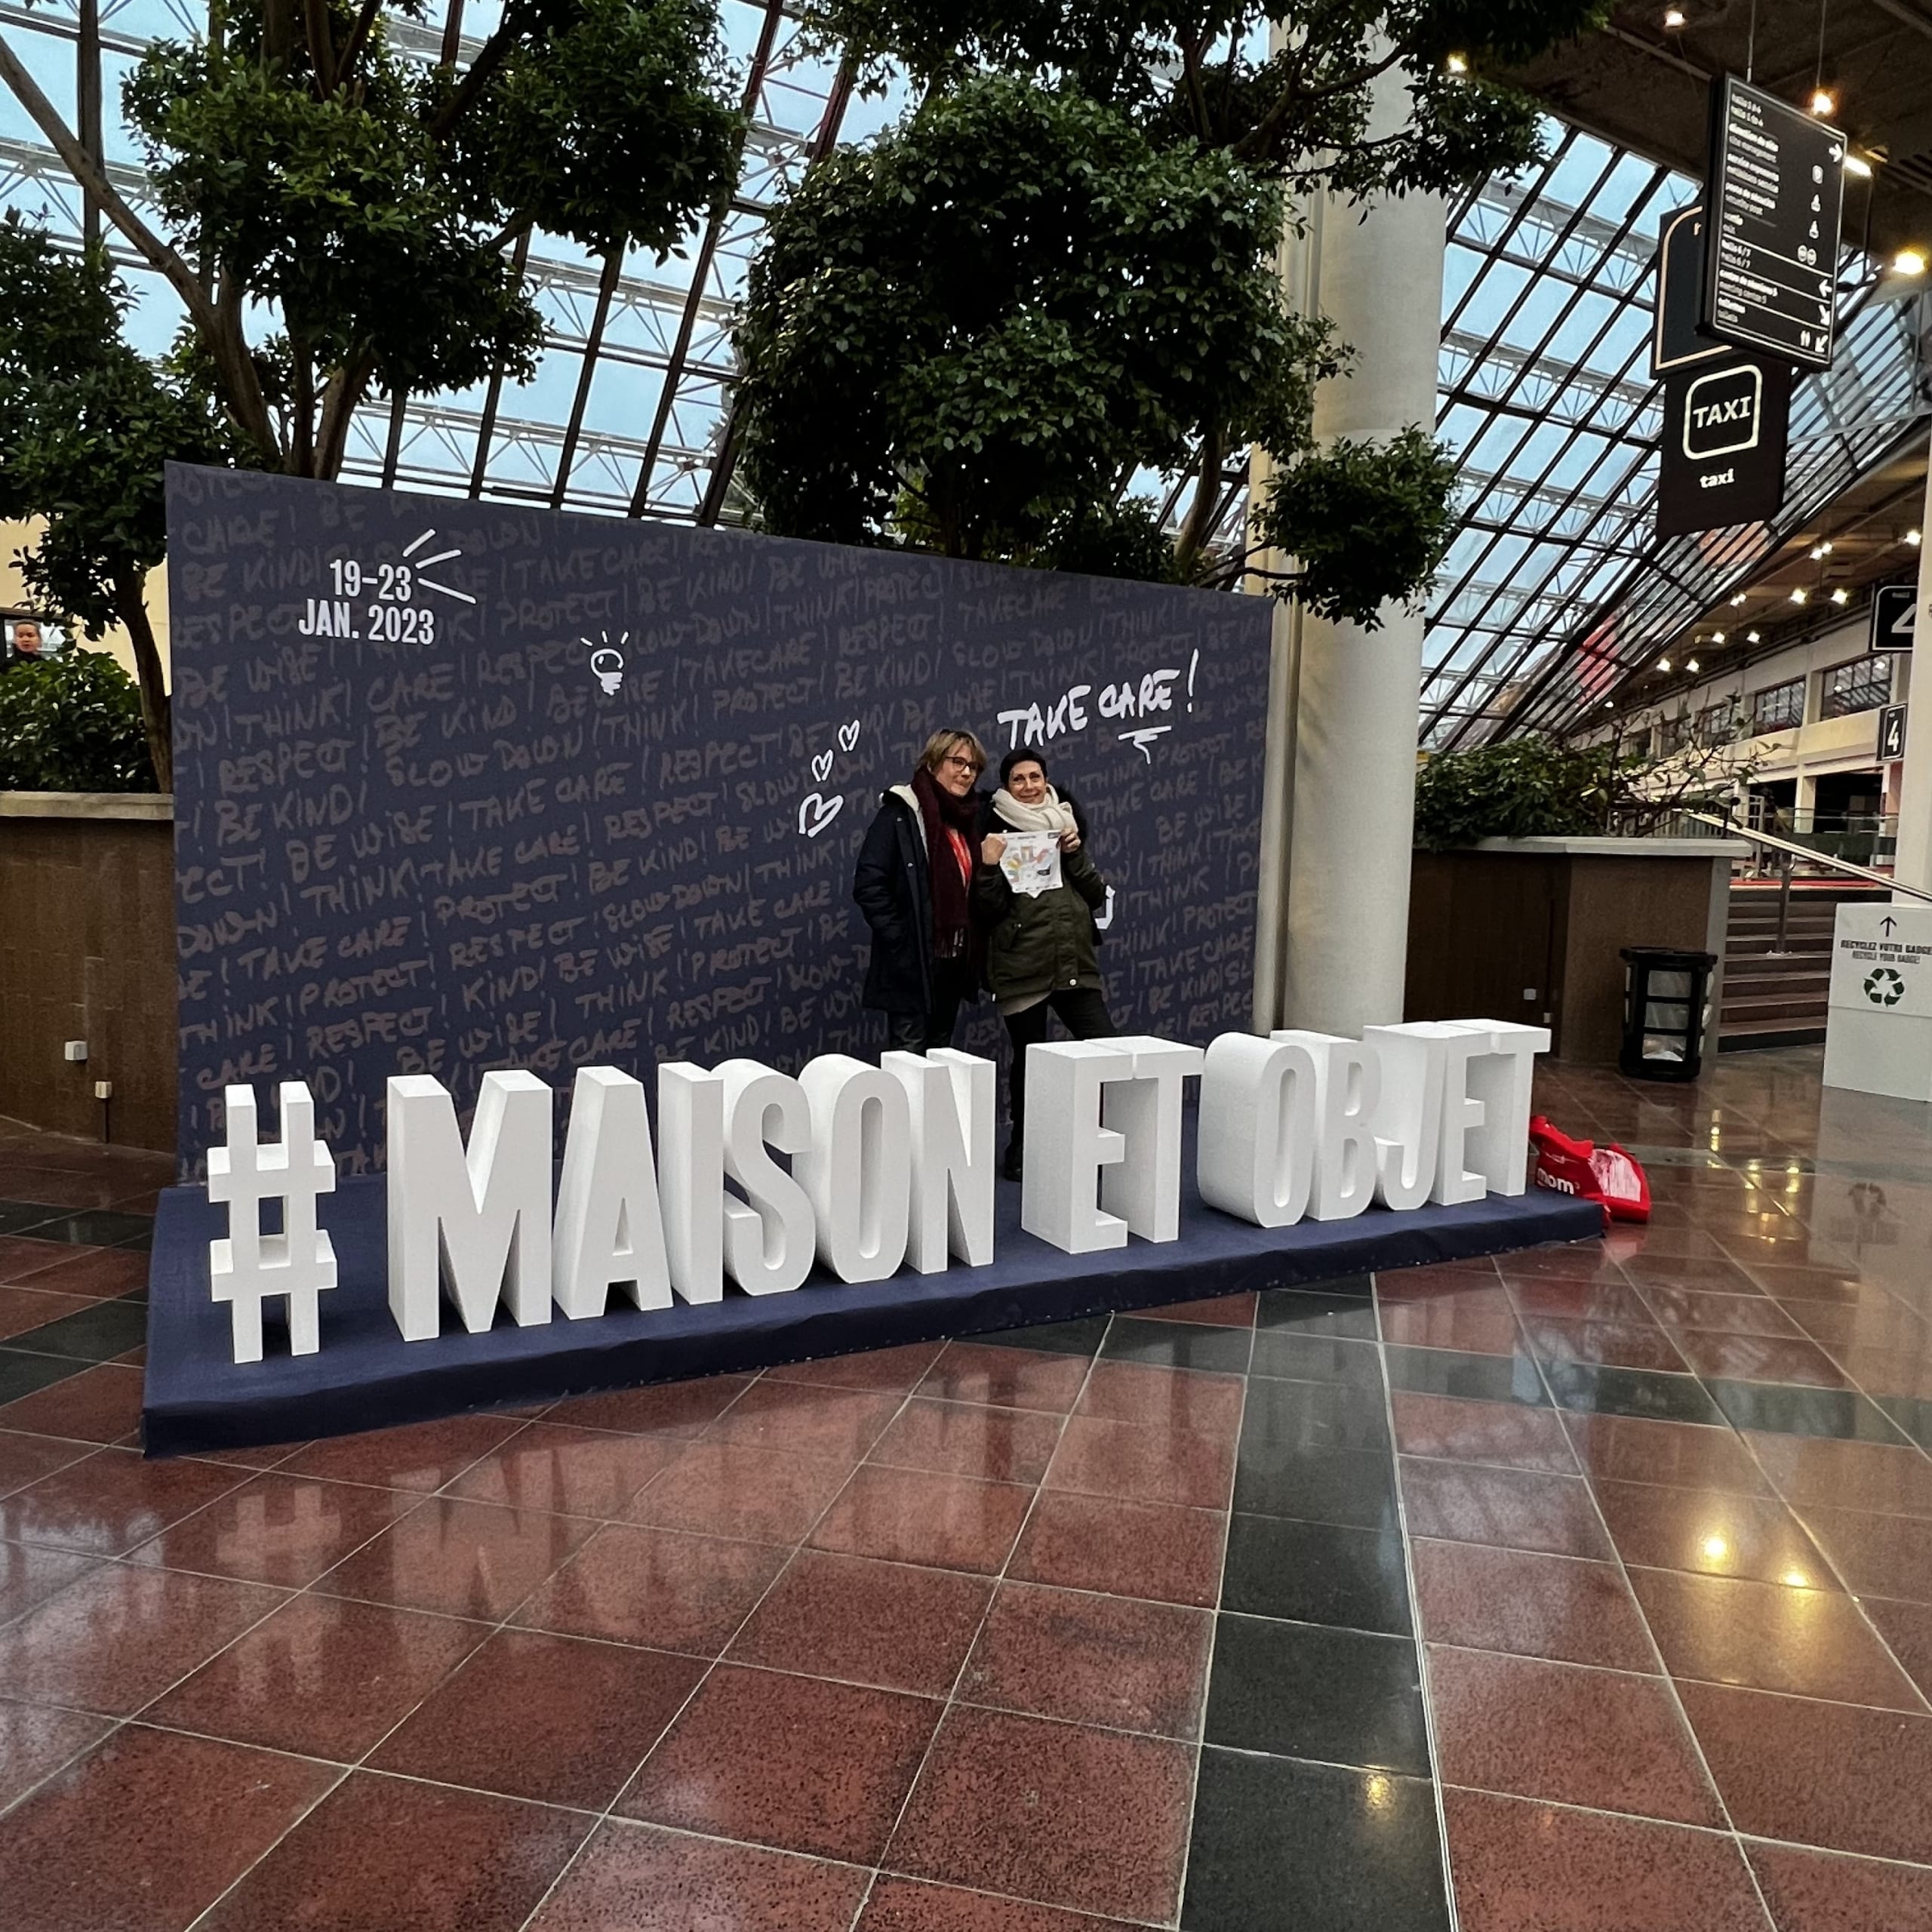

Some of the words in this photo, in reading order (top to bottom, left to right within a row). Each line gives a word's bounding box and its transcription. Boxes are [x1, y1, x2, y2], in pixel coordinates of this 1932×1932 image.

[1693, 395, 1752, 428] TAXI
[1700, 468, 1735, 488] taxi
[328, 558, 413, 603] 19-23
[297, 598, 361, 641] JAN.
[367, 603, 435, 646] 2023
[996, 684, 1092, 751] TAKE
[1887, 718, 1900, 752] 4
[1020, 1035, 1206, 1255] ET
[1197, 1017, 1552, 1229] OBJET
